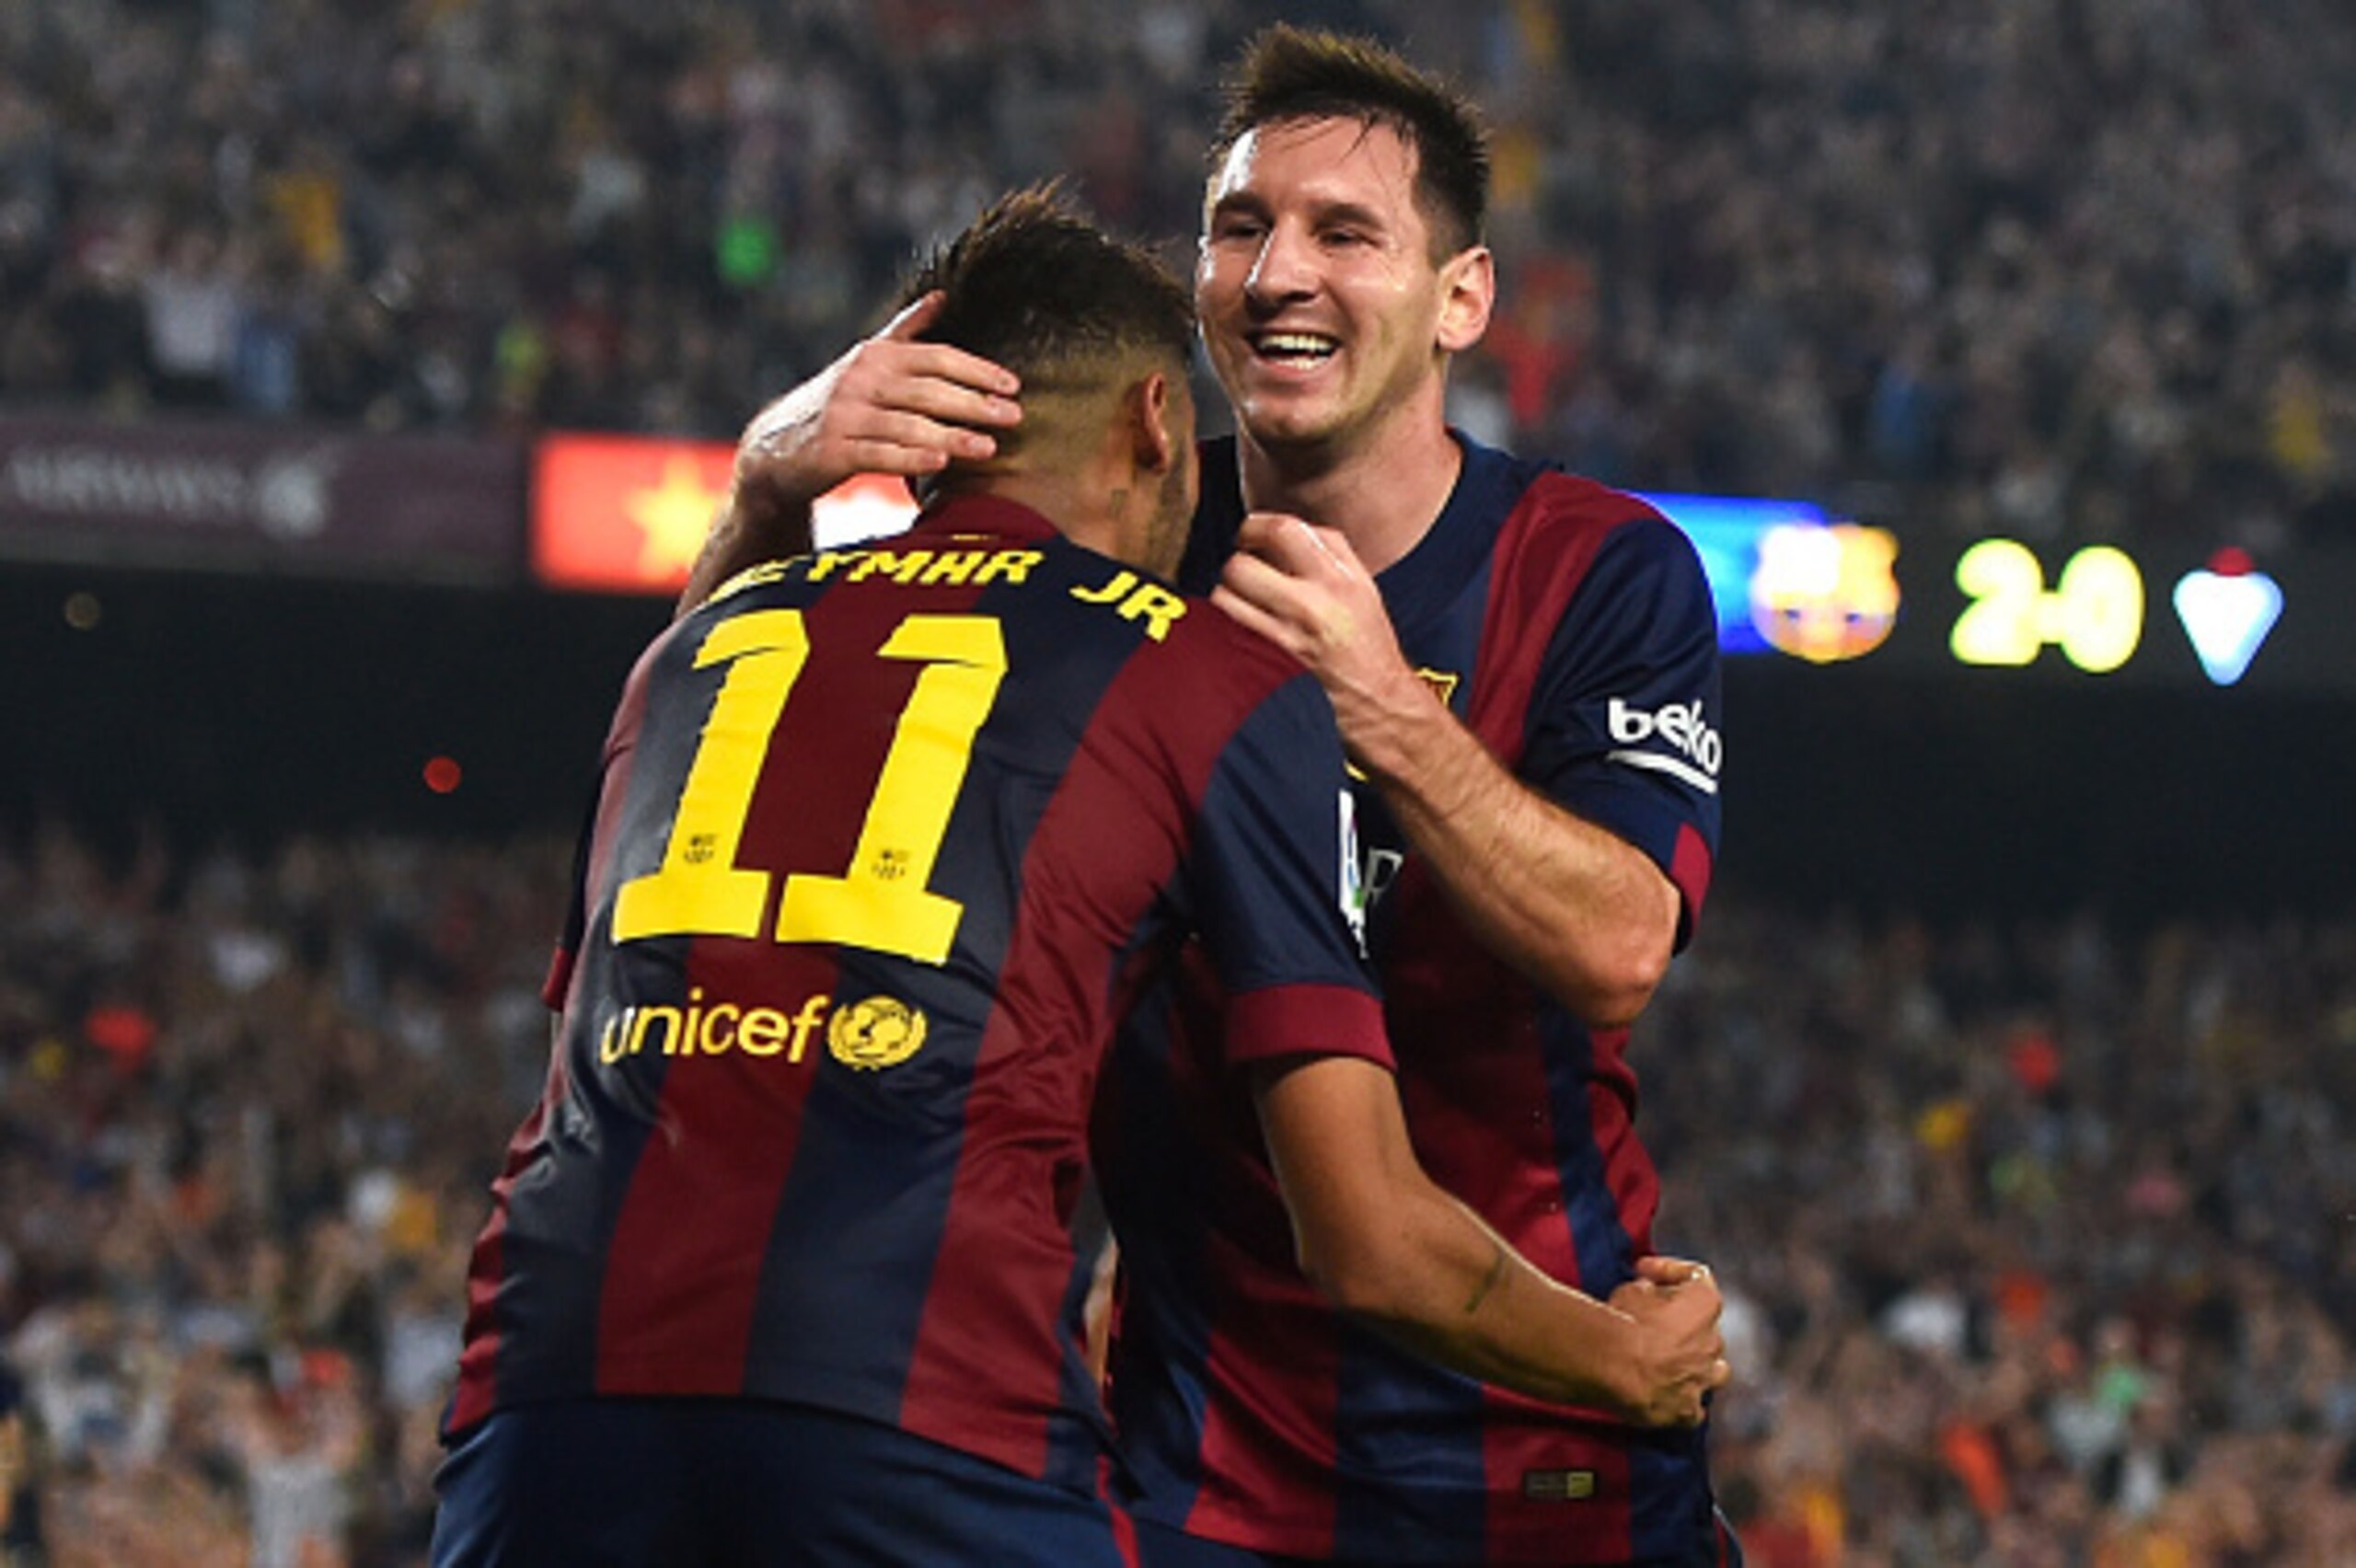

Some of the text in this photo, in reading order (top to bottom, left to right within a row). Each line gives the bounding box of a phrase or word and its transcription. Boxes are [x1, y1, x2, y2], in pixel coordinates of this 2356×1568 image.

[1069, 571, 1187, 642] JR
[1949, 537, 2146, 674] 2-0
[1609, 698, 1723, 775] beko
[612, 609, 1009, 965] 11
[601, 987, 830, 1064] unicef
